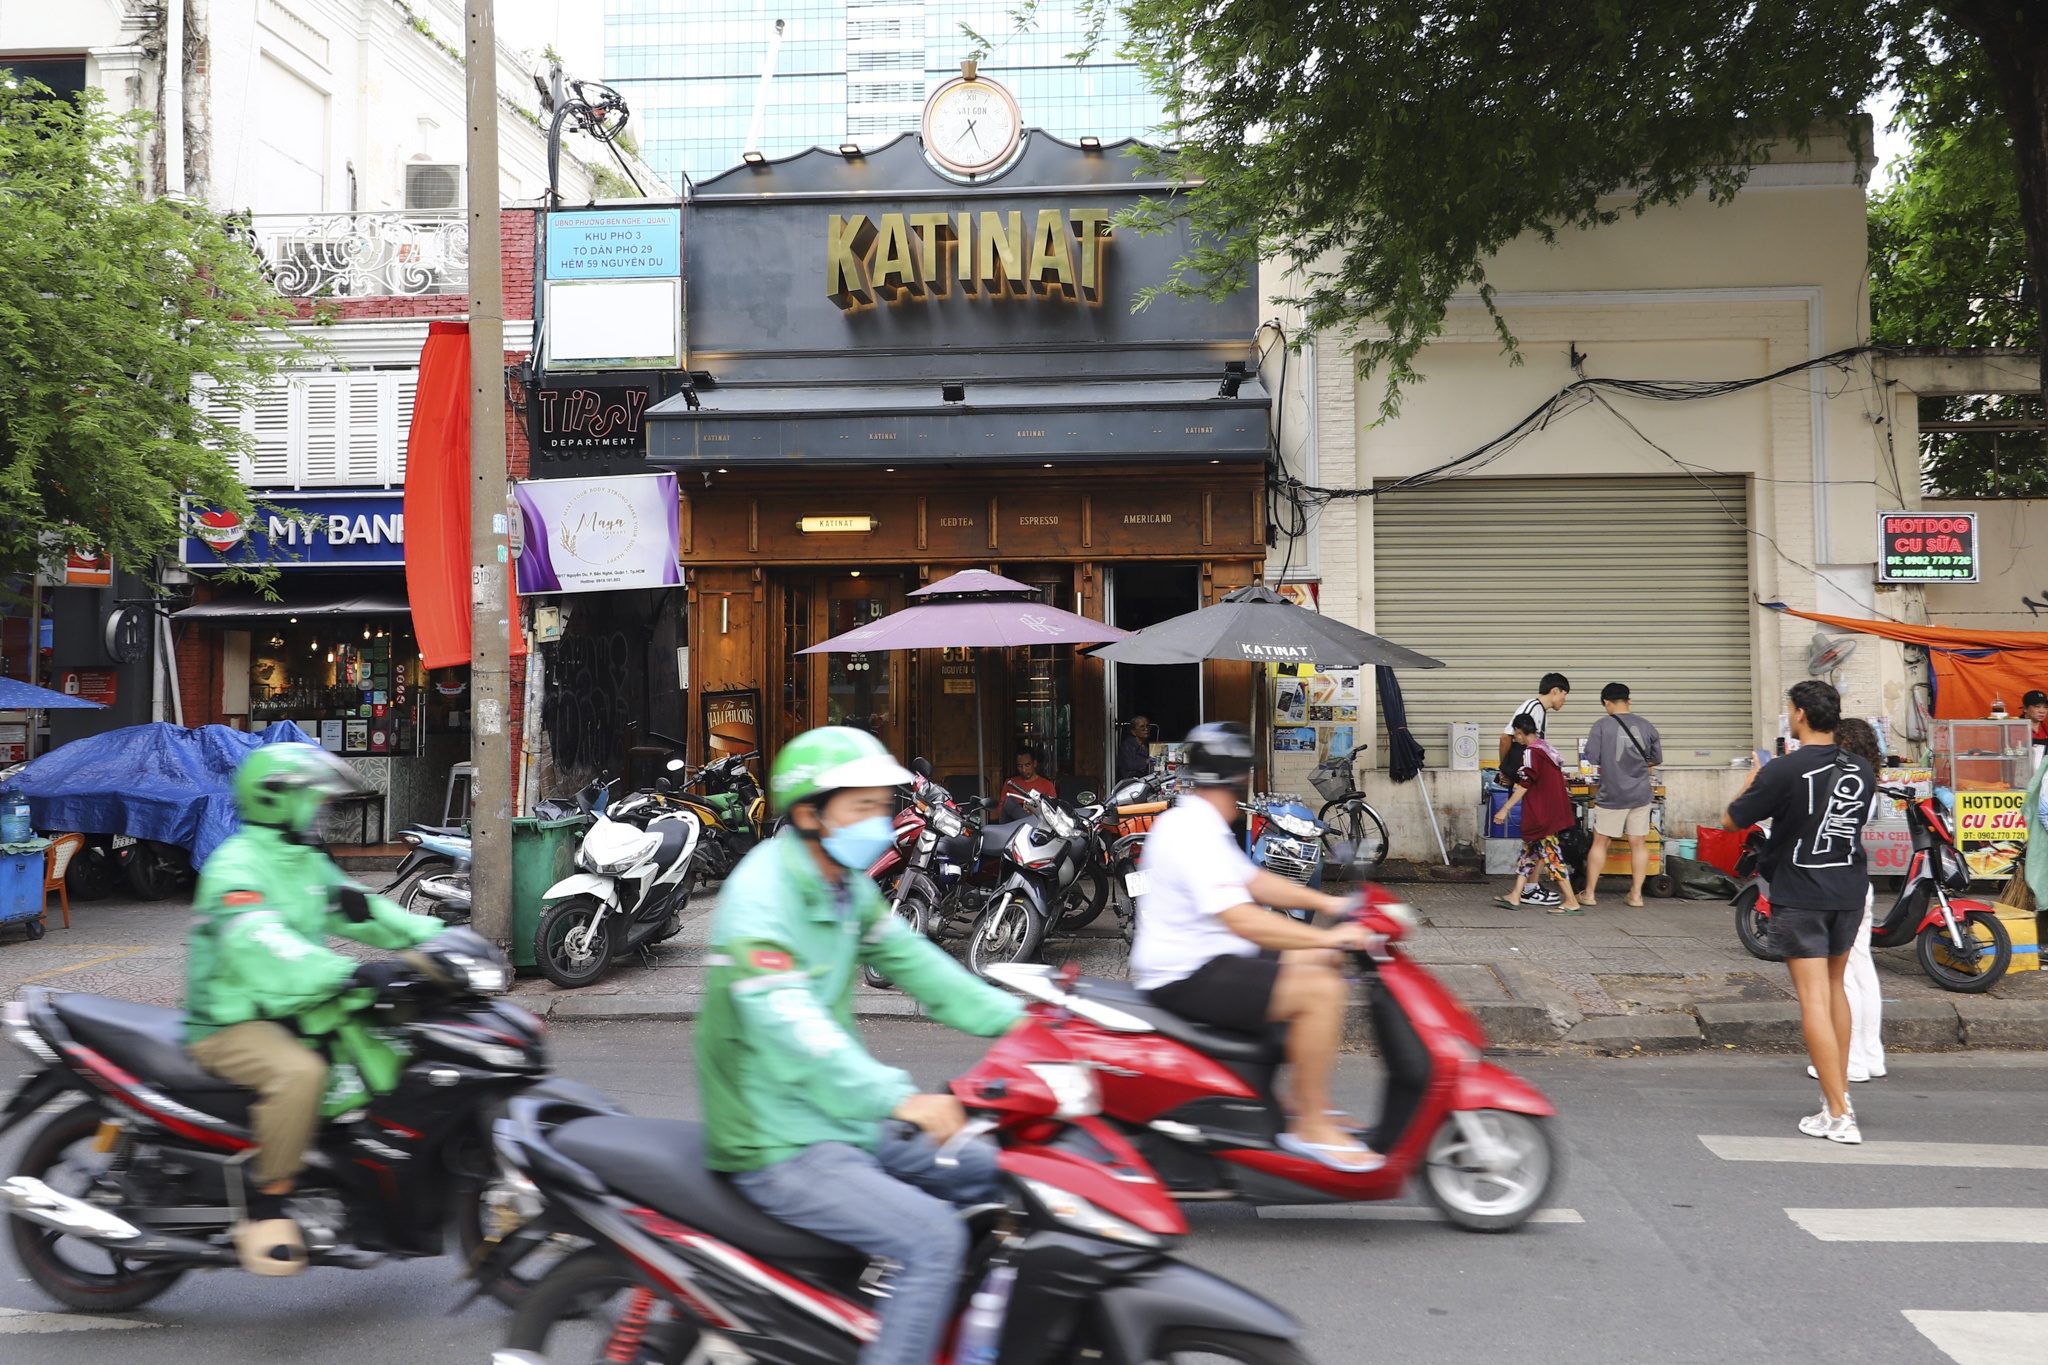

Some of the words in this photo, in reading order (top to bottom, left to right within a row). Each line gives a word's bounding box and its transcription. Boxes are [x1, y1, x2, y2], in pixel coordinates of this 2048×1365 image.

[585, 232, 607, 241] KHU
[636, 231, 642, 240] 3
[590, 244, 613, 255] DÂN
[641, 245, 653, 254] 29
[827, 208, 1111, 306] KATINAT
[587, 259, 598, 268] 59
[648, 257, 663, 267] DU
[1017, 430, 1046, 438] KATINAT
[1185, 426, 1214, 434] KATINAT
[551, 437, 635, 447] DEPARTMENT
[703, 434, 730, 442] KATINAT
[869, 433, 897, 441] KATINAT
[819, 519, 853, 528] KATINAT
[1019, 516, 1058, 526] ESPRESSO
[1123, 514, 1172, 524] AMERICANO
[268, 515, 323, 546] MY
[575, 511, 626, 540] Maya
[1894, 537, 1922, 553] CU
[1926, 534, 1963, 553] SỮA
[1904, 556, 1930, 565] 0902
[1939, 569, 1952, 577] DU
[1241, 643, 1308, 657] KATINAT
[1962, 814, 1986, 828] CU
